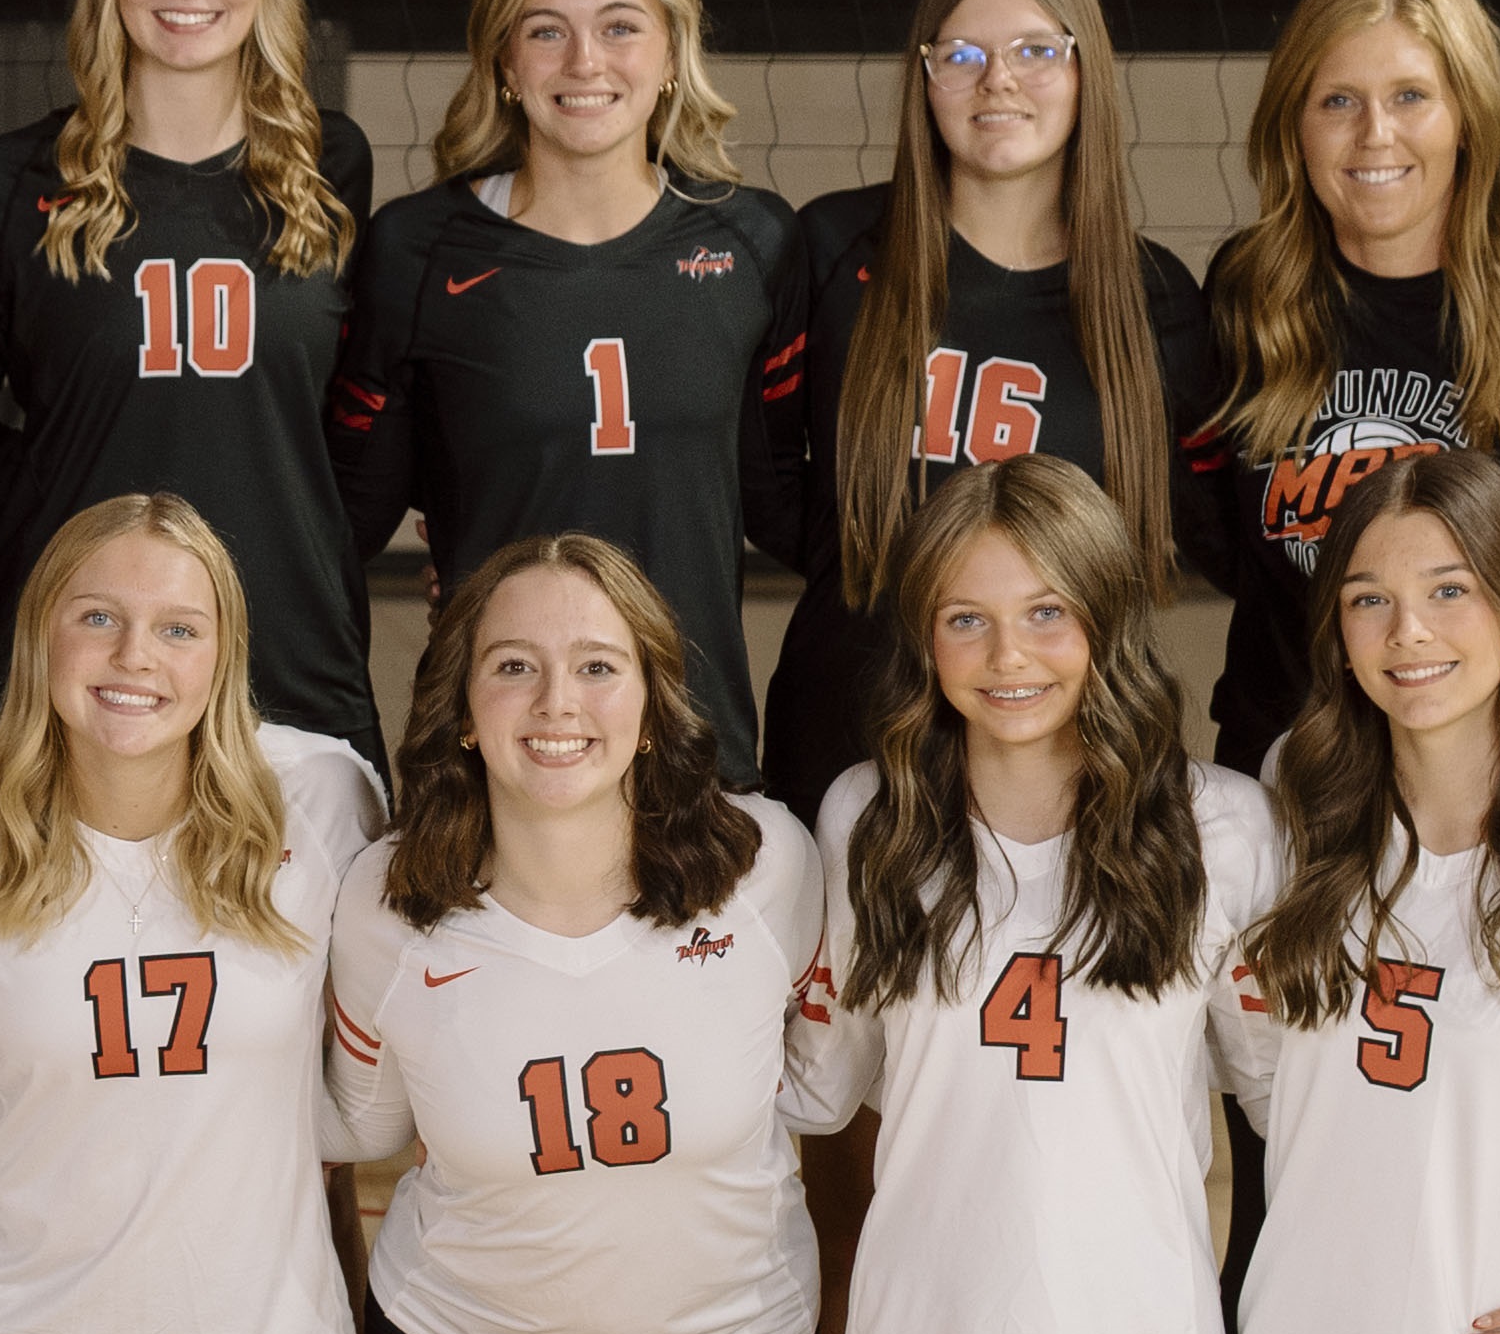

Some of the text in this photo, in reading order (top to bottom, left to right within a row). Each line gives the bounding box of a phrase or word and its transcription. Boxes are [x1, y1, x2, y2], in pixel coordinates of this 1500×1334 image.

[134, 258, 256, 378] 10
[583, 338, 635, 455] 1
[912, 347, 1048, 466] 16
[1265, 442, 1441, 527] MP
[84, 951, 217, 1079] 17
[980, 952, 1068, 1082] 4
[1357, 957, 1446, 1092] 5
[518, 1047, 671, 1176] 18
